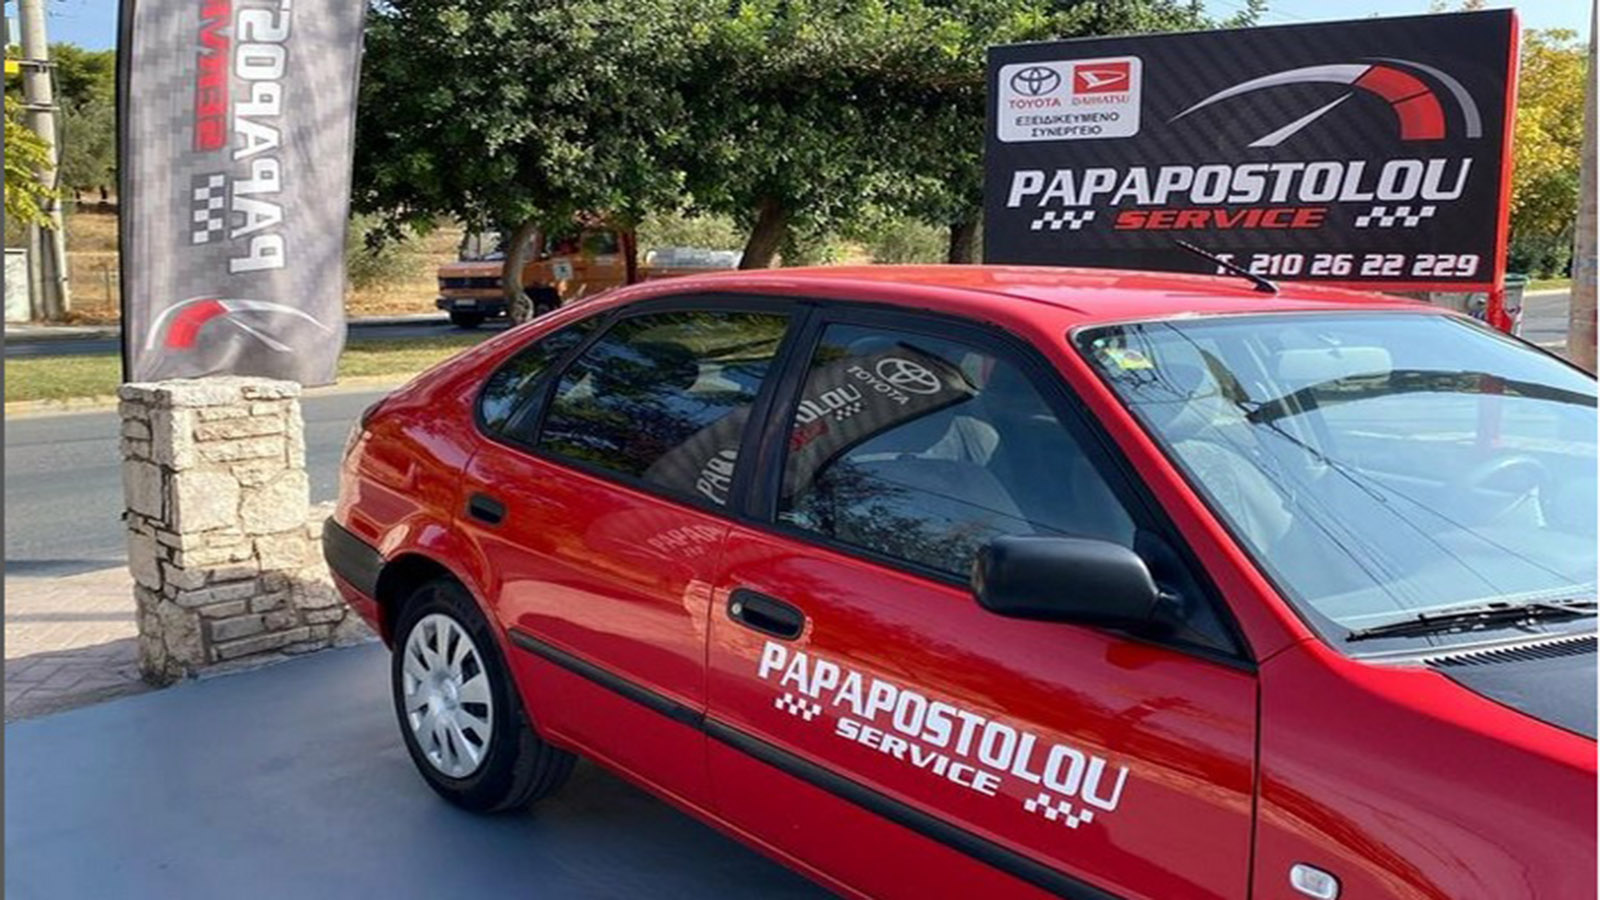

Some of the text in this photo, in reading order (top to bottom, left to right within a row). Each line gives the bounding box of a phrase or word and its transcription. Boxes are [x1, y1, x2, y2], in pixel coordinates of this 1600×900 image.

[1009, 98, 1061, 109] TOYOTA
[1031, 125, 1102, 138] ΣΥΝΕΡΓΕΙΟ
[1006, 158, 1472, 207] PAPAPOSTOLOU
[1113, 208, 1327, 230] SERVICE
[1250, 254, 1303, 276] 210
[1310, 254, 1354, 276] 26
[1360, 254, 1404, 276] 22
[1411, 254, 1479, 276] 229
[846, 365, 910, 405] TOYOTA
[758, 640, 1129, 811] PAPAPOSTOLOU
[835, 717, 1001, 796] SERVICE
